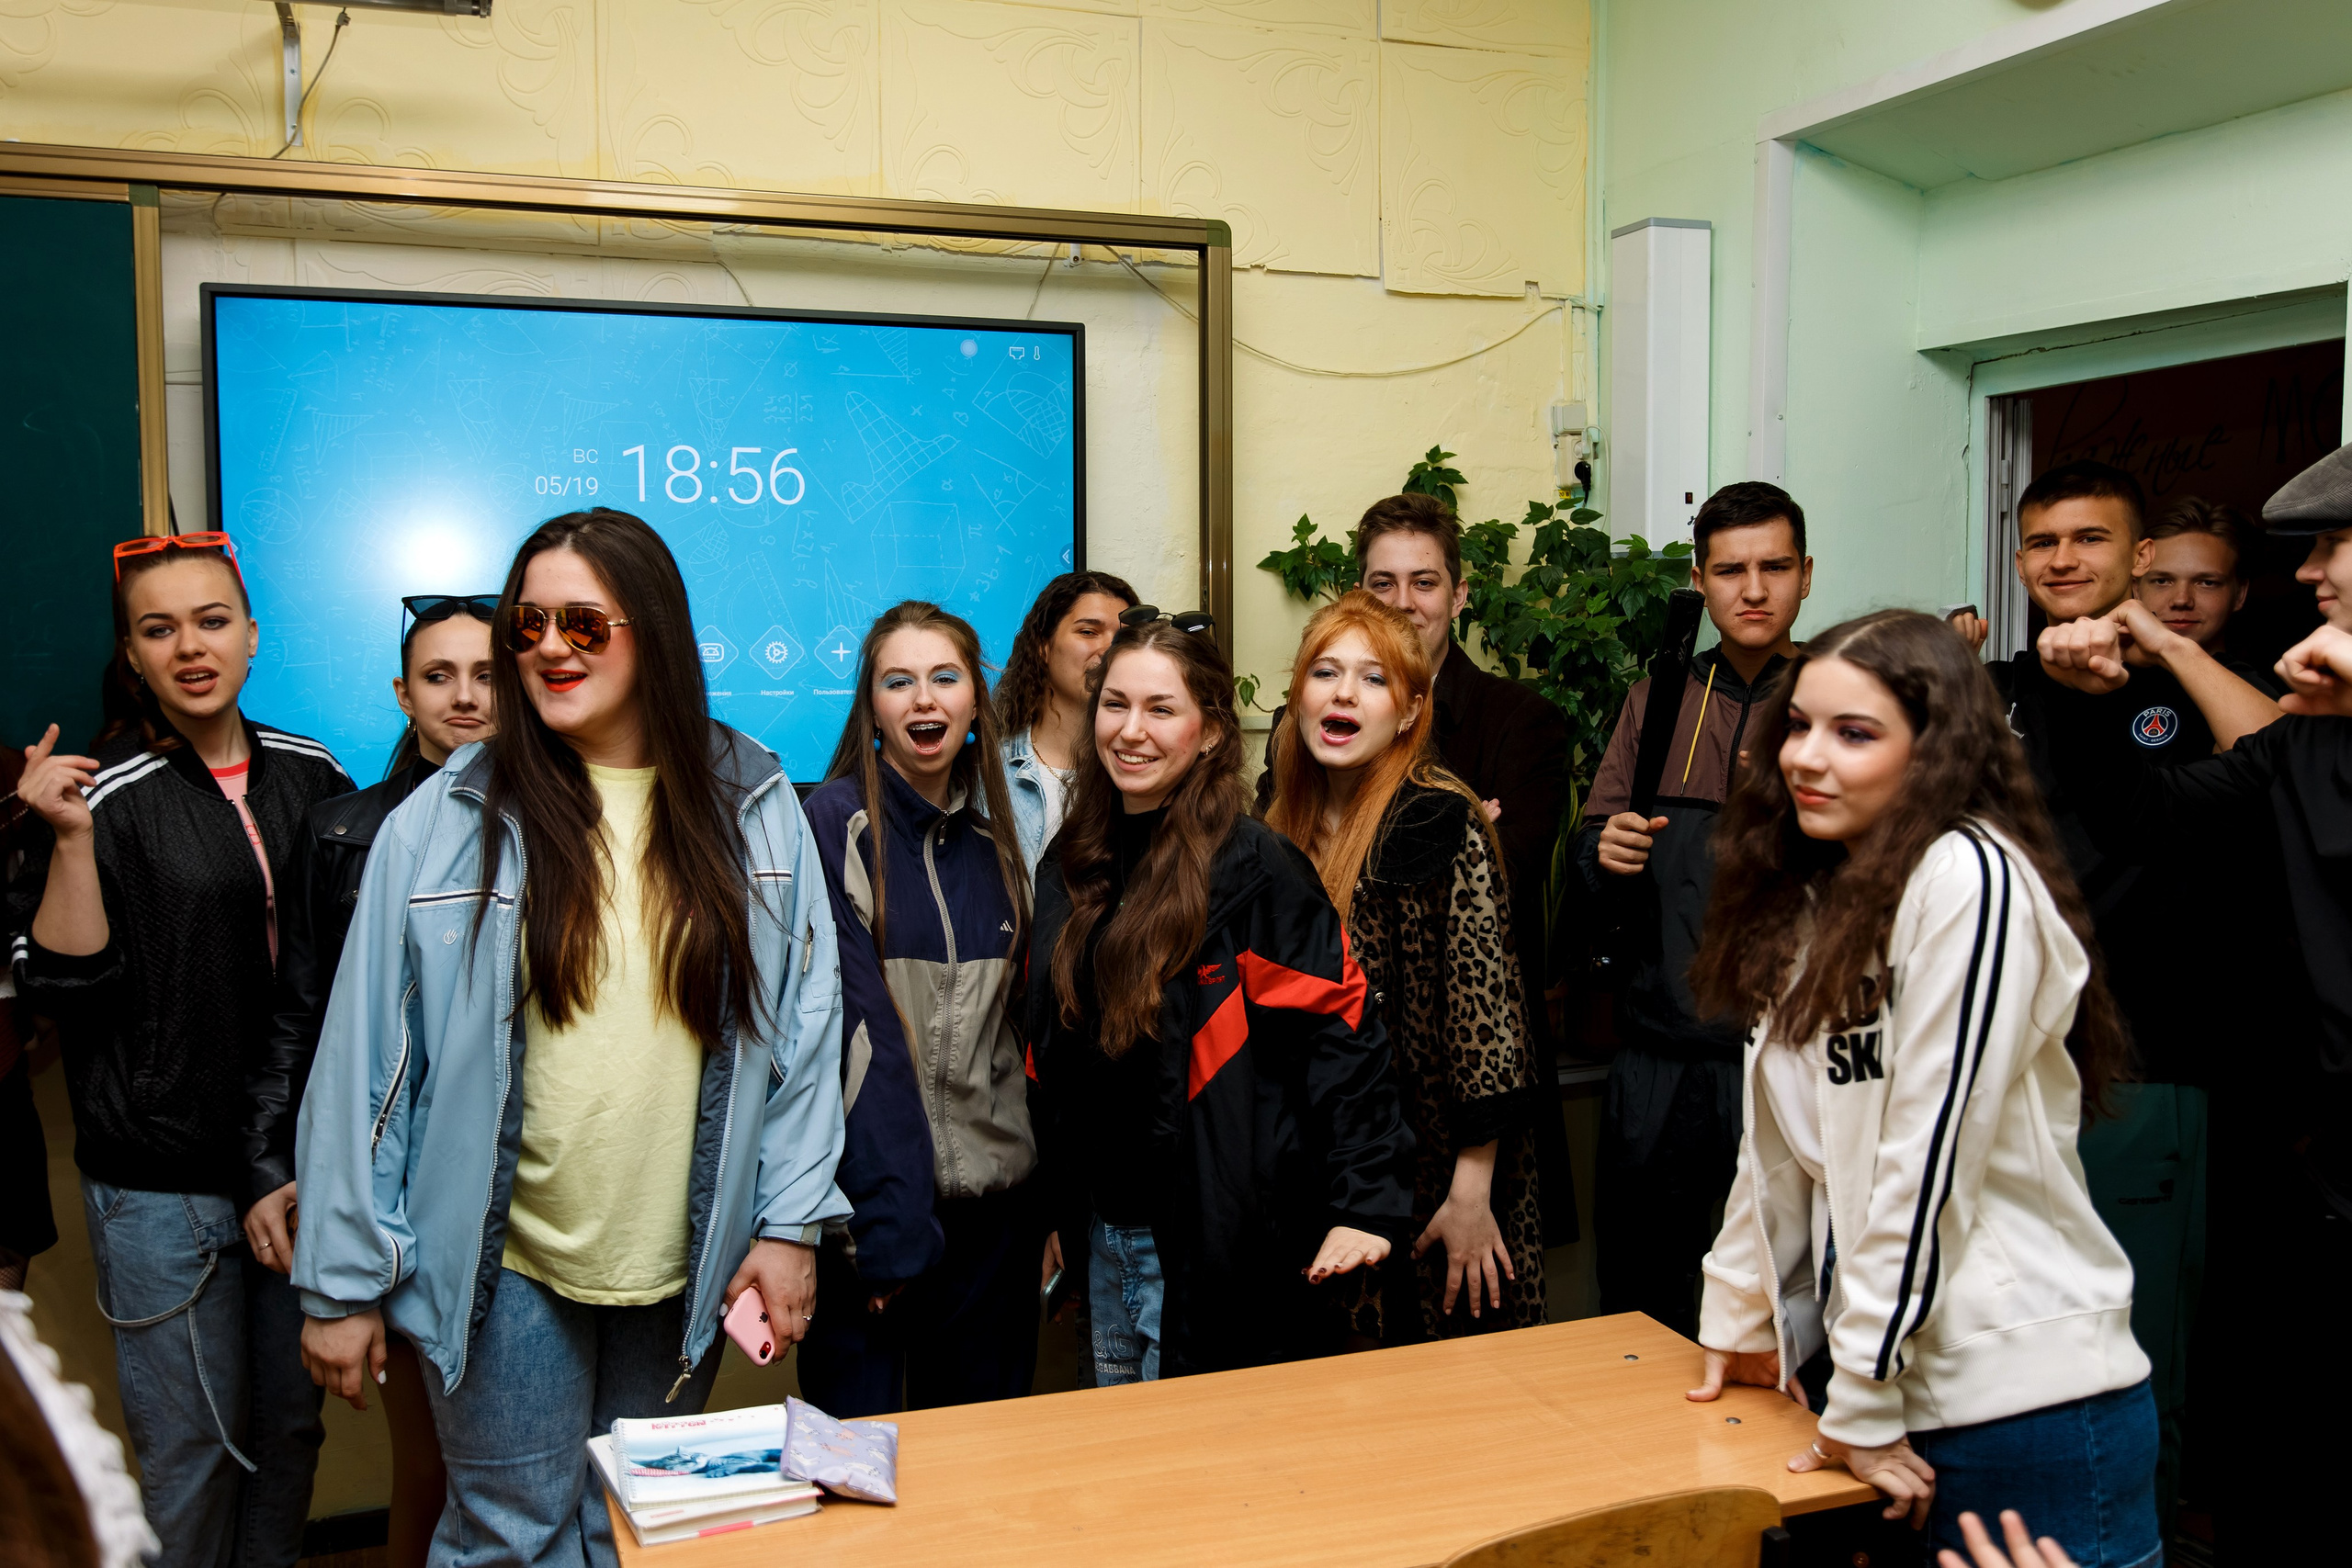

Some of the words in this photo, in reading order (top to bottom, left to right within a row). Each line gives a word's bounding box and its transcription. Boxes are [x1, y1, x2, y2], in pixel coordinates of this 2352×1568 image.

[573, 448, 599, 464] ВС
[622, 444, 806, 505] 18:56
[535, 476, 599, 497] 05/19
[2143, 708, 2171, 717] PARIS
[1826, 1029, 1884, 1086] SK
